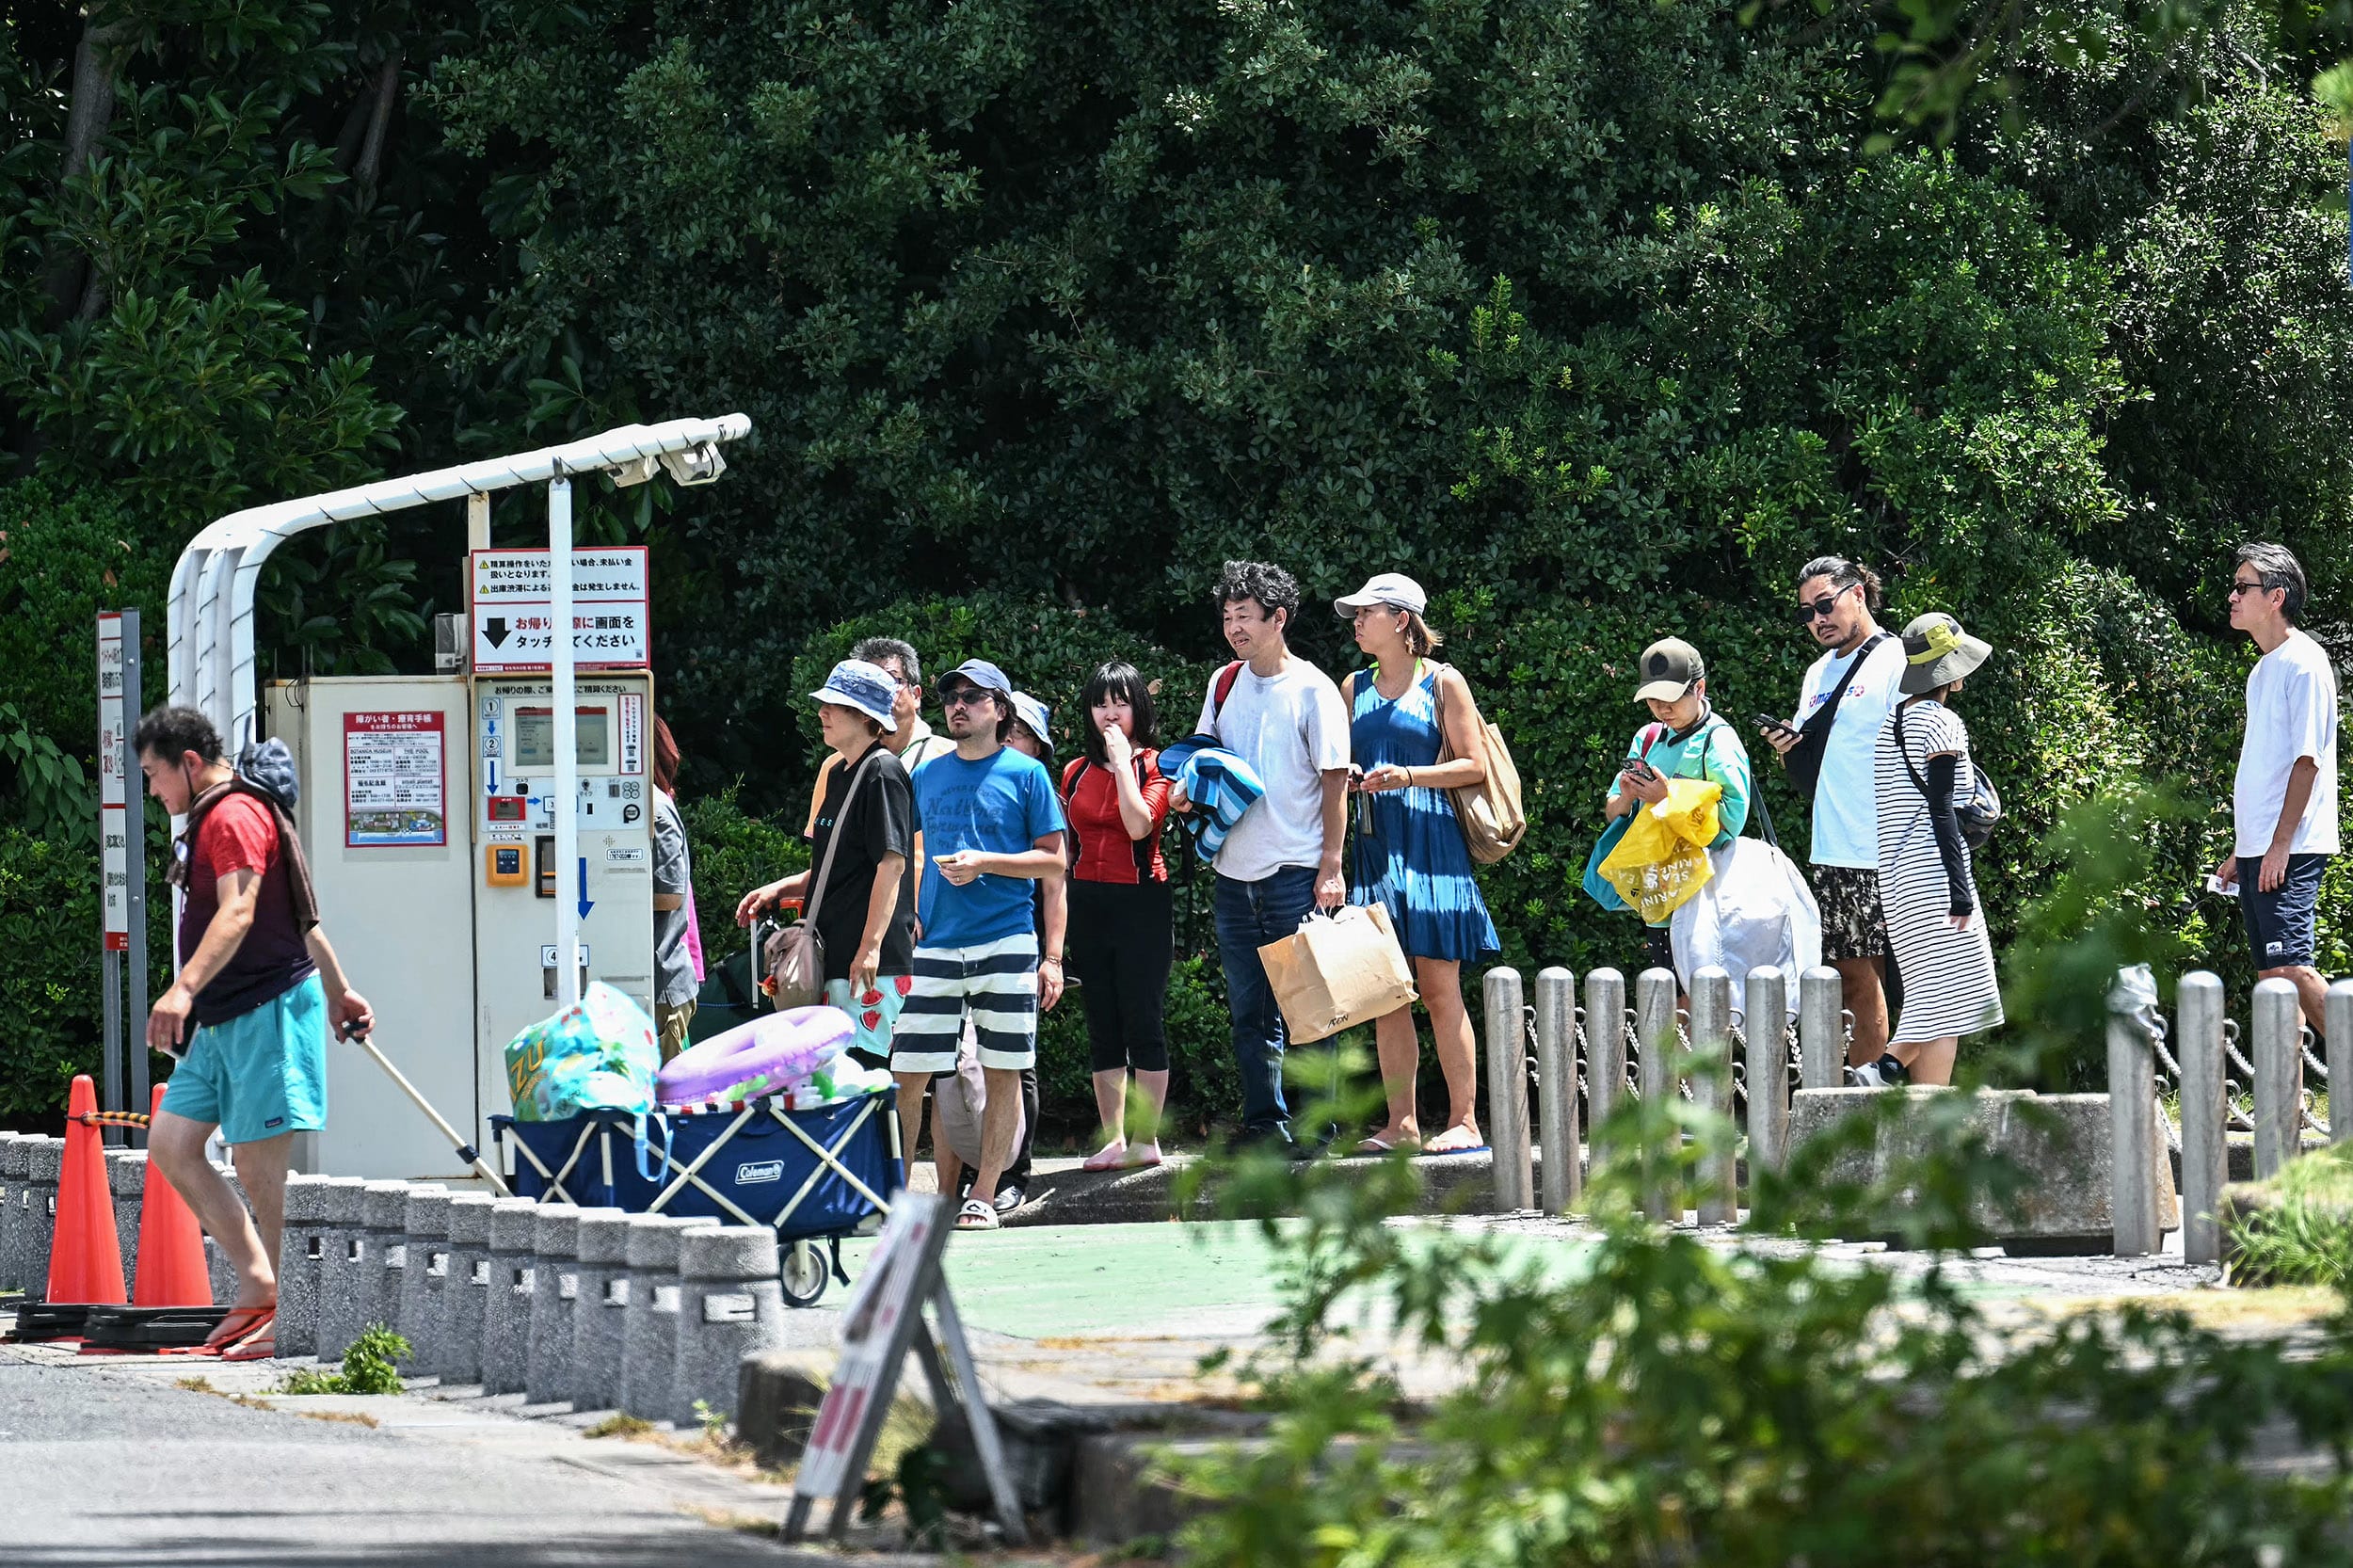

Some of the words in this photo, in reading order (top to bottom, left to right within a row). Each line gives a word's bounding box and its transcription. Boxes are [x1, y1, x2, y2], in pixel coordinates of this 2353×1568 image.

[517, 634, 635, 648] タッチてください
[740, 1166, 773, 1178] Coleman
